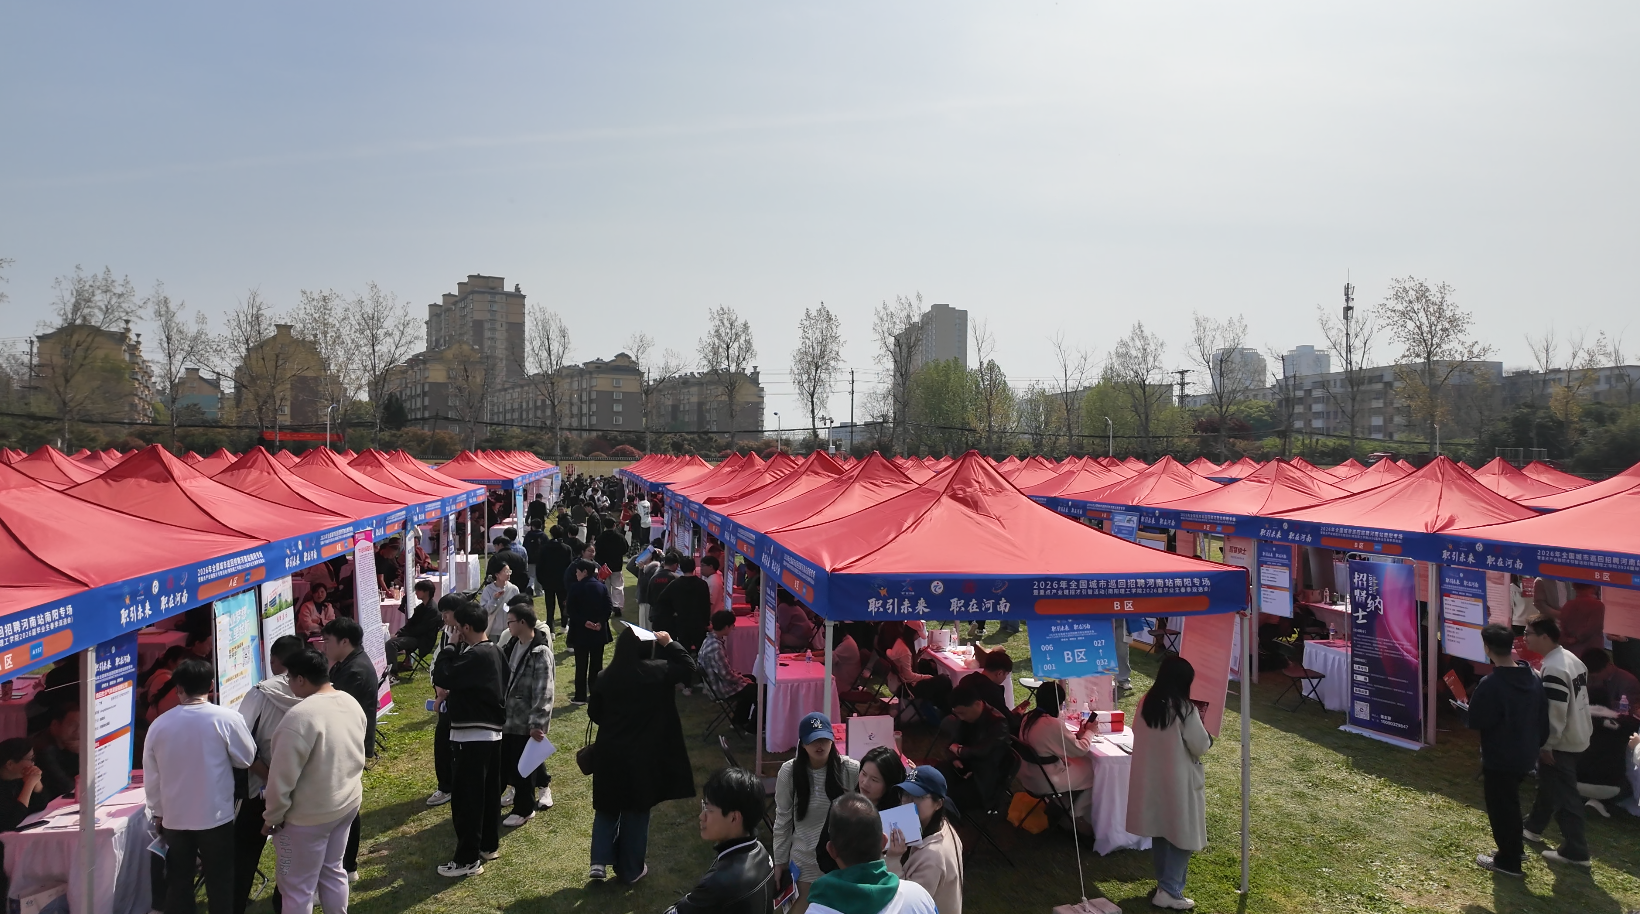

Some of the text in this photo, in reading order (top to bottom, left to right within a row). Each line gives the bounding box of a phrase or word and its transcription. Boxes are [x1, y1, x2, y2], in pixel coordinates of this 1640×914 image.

[1259, 528, 1283, 539] 职引未来
[1288, 531, 1313, 543] 职在河南
[1442, 549, 1524, 570] 职引未来 职在河南
[1033, 577, 1211, 590] 2026年全国城市巡回招聘河南站南阳专场
[120, 589, 189, 628] 职引未来 职在河南
[867, 597, 1011, 616] 职引未来 职在河南
[1093, 639, 1105, 647] 027
[1063, 648, 1088, 663] B区
[1096, 658, 1109, 666] 032
[1043, 663, 1056, 671] 001
